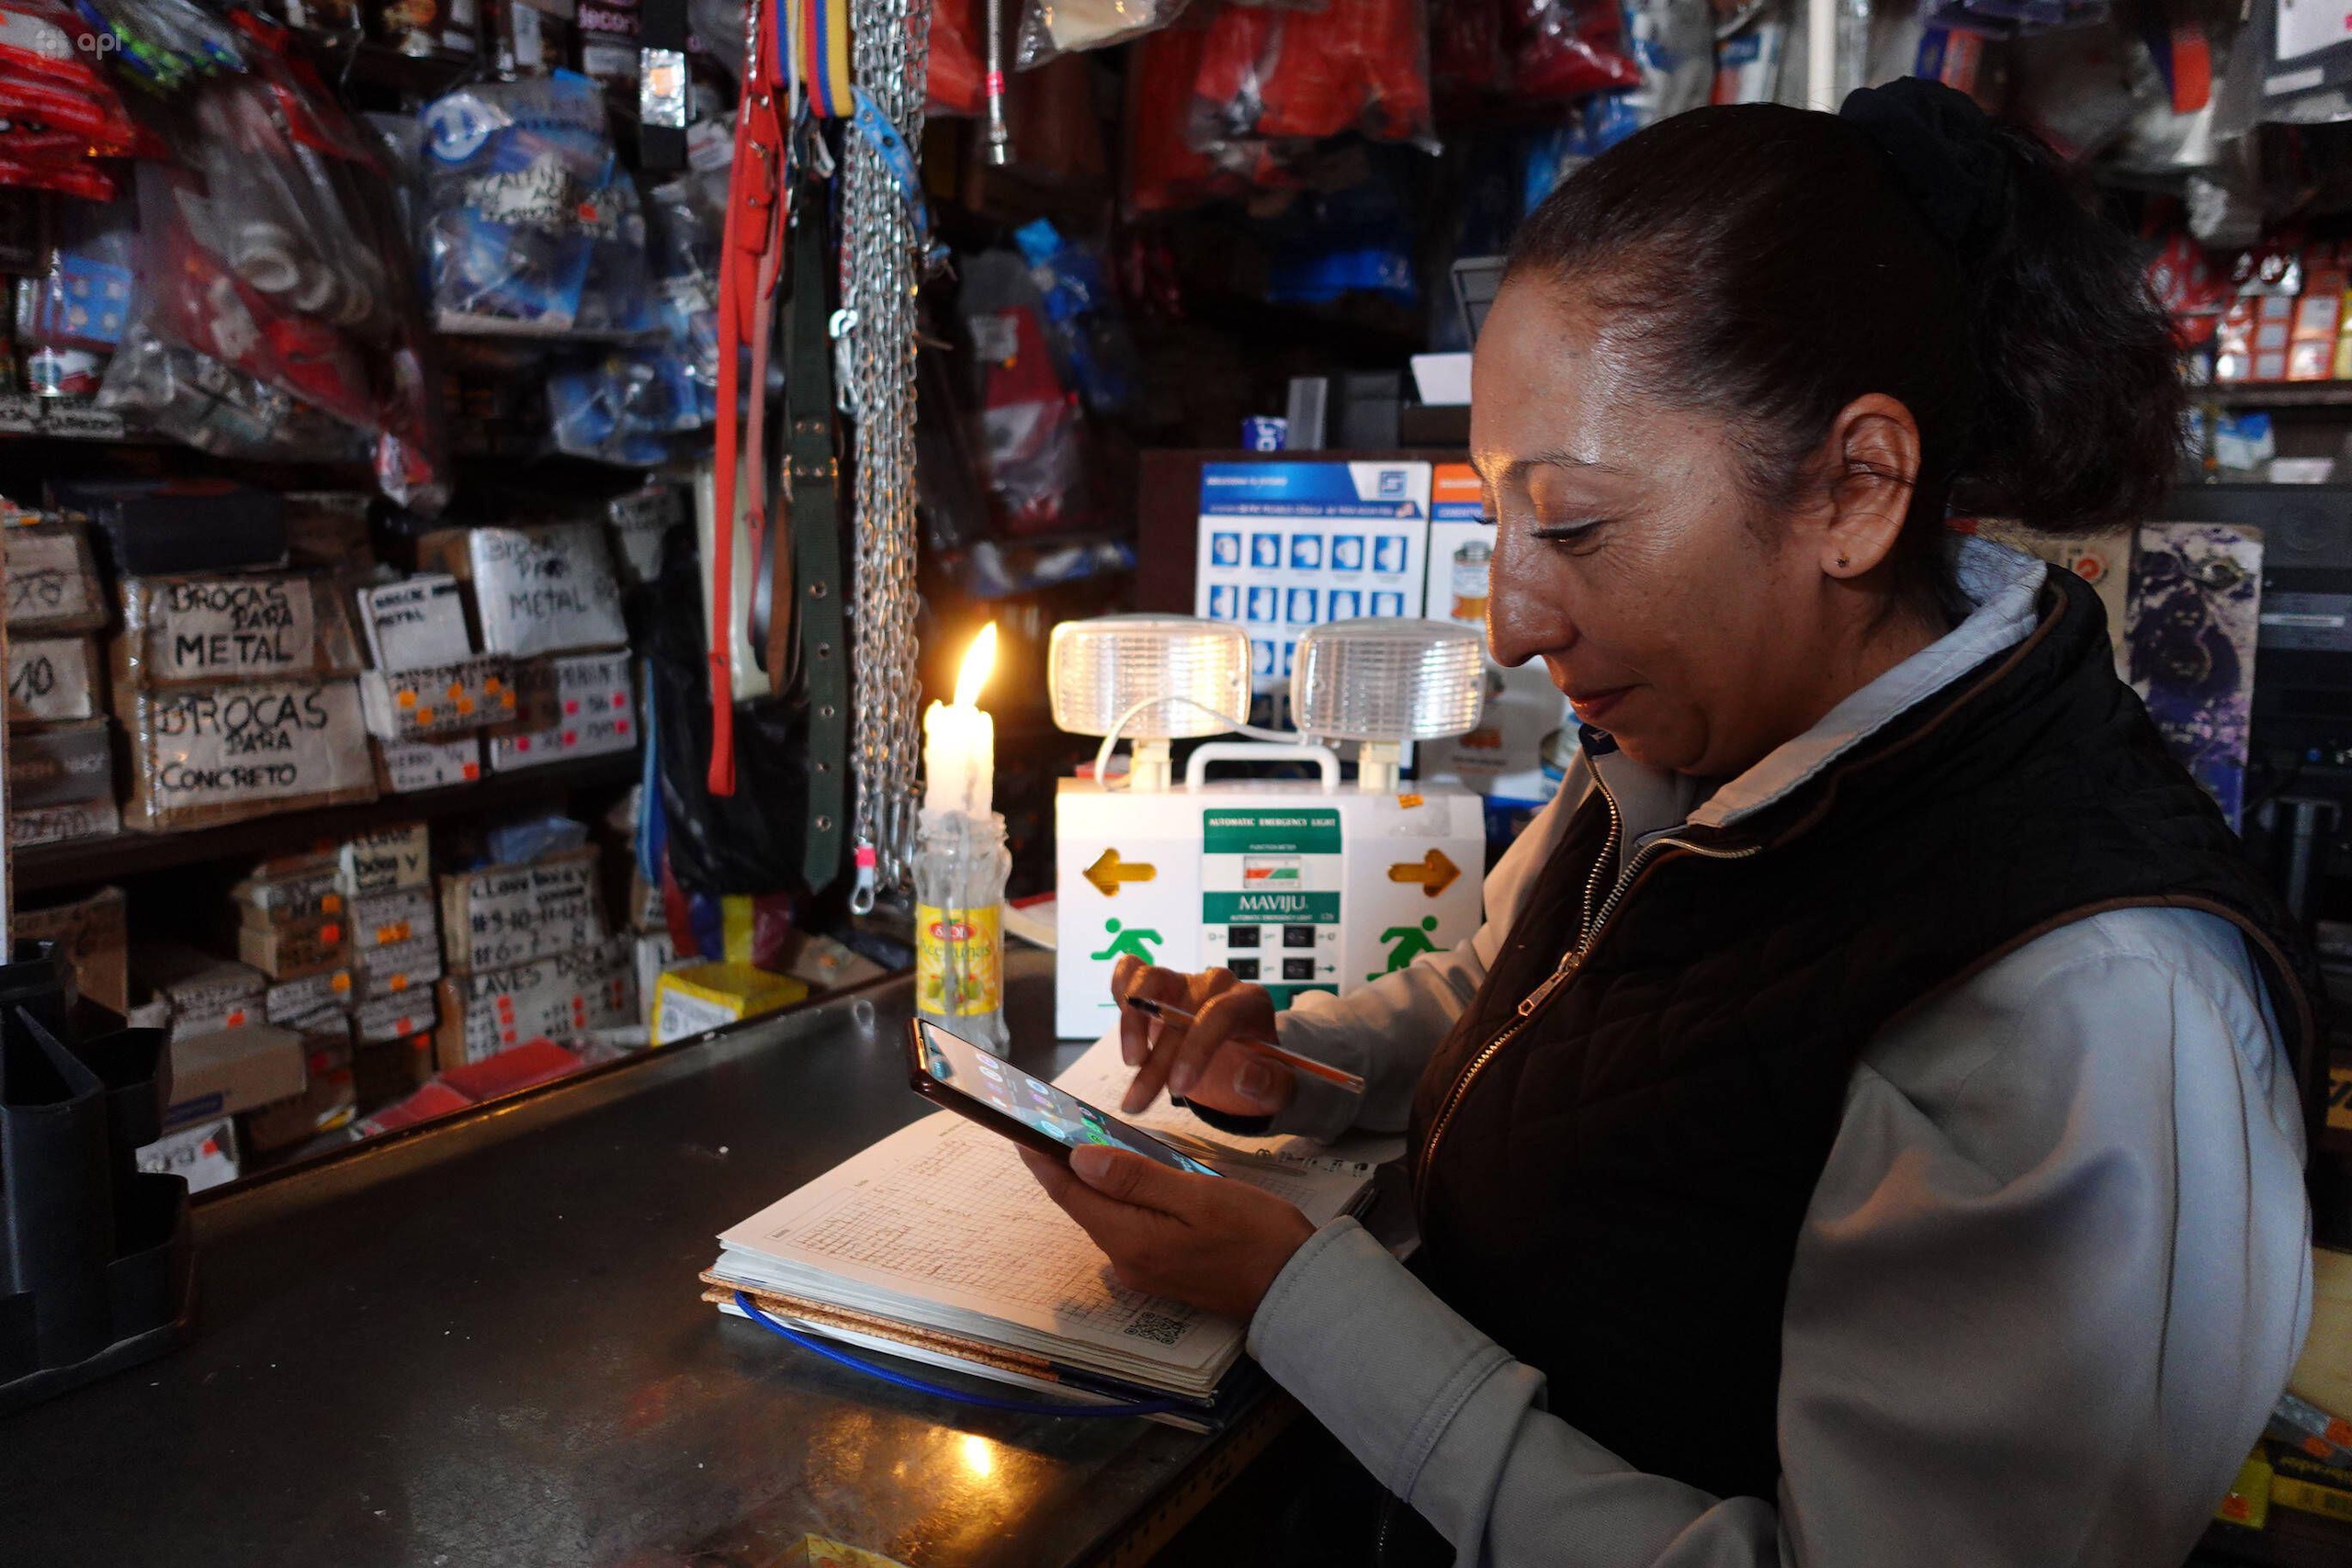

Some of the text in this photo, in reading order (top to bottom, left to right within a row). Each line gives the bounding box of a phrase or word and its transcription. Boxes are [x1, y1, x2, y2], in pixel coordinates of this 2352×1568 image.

[169, 583, 288, 612] BROCAS
[508, 586, 588, 620] METAL
[232, 604, 294, 630] PARA
[175, 629, 295, 667] METAL
[156, 692, 328, 735] BROCAS
[226, 730, 292, 755] PARA
[160, 761, 298, 792] CONCRETO
[1209, 818, 1336, 828] AUTOMATIC EMERGENCY LIGHT
[1238, 895, 1306, 913] MAVIJU
